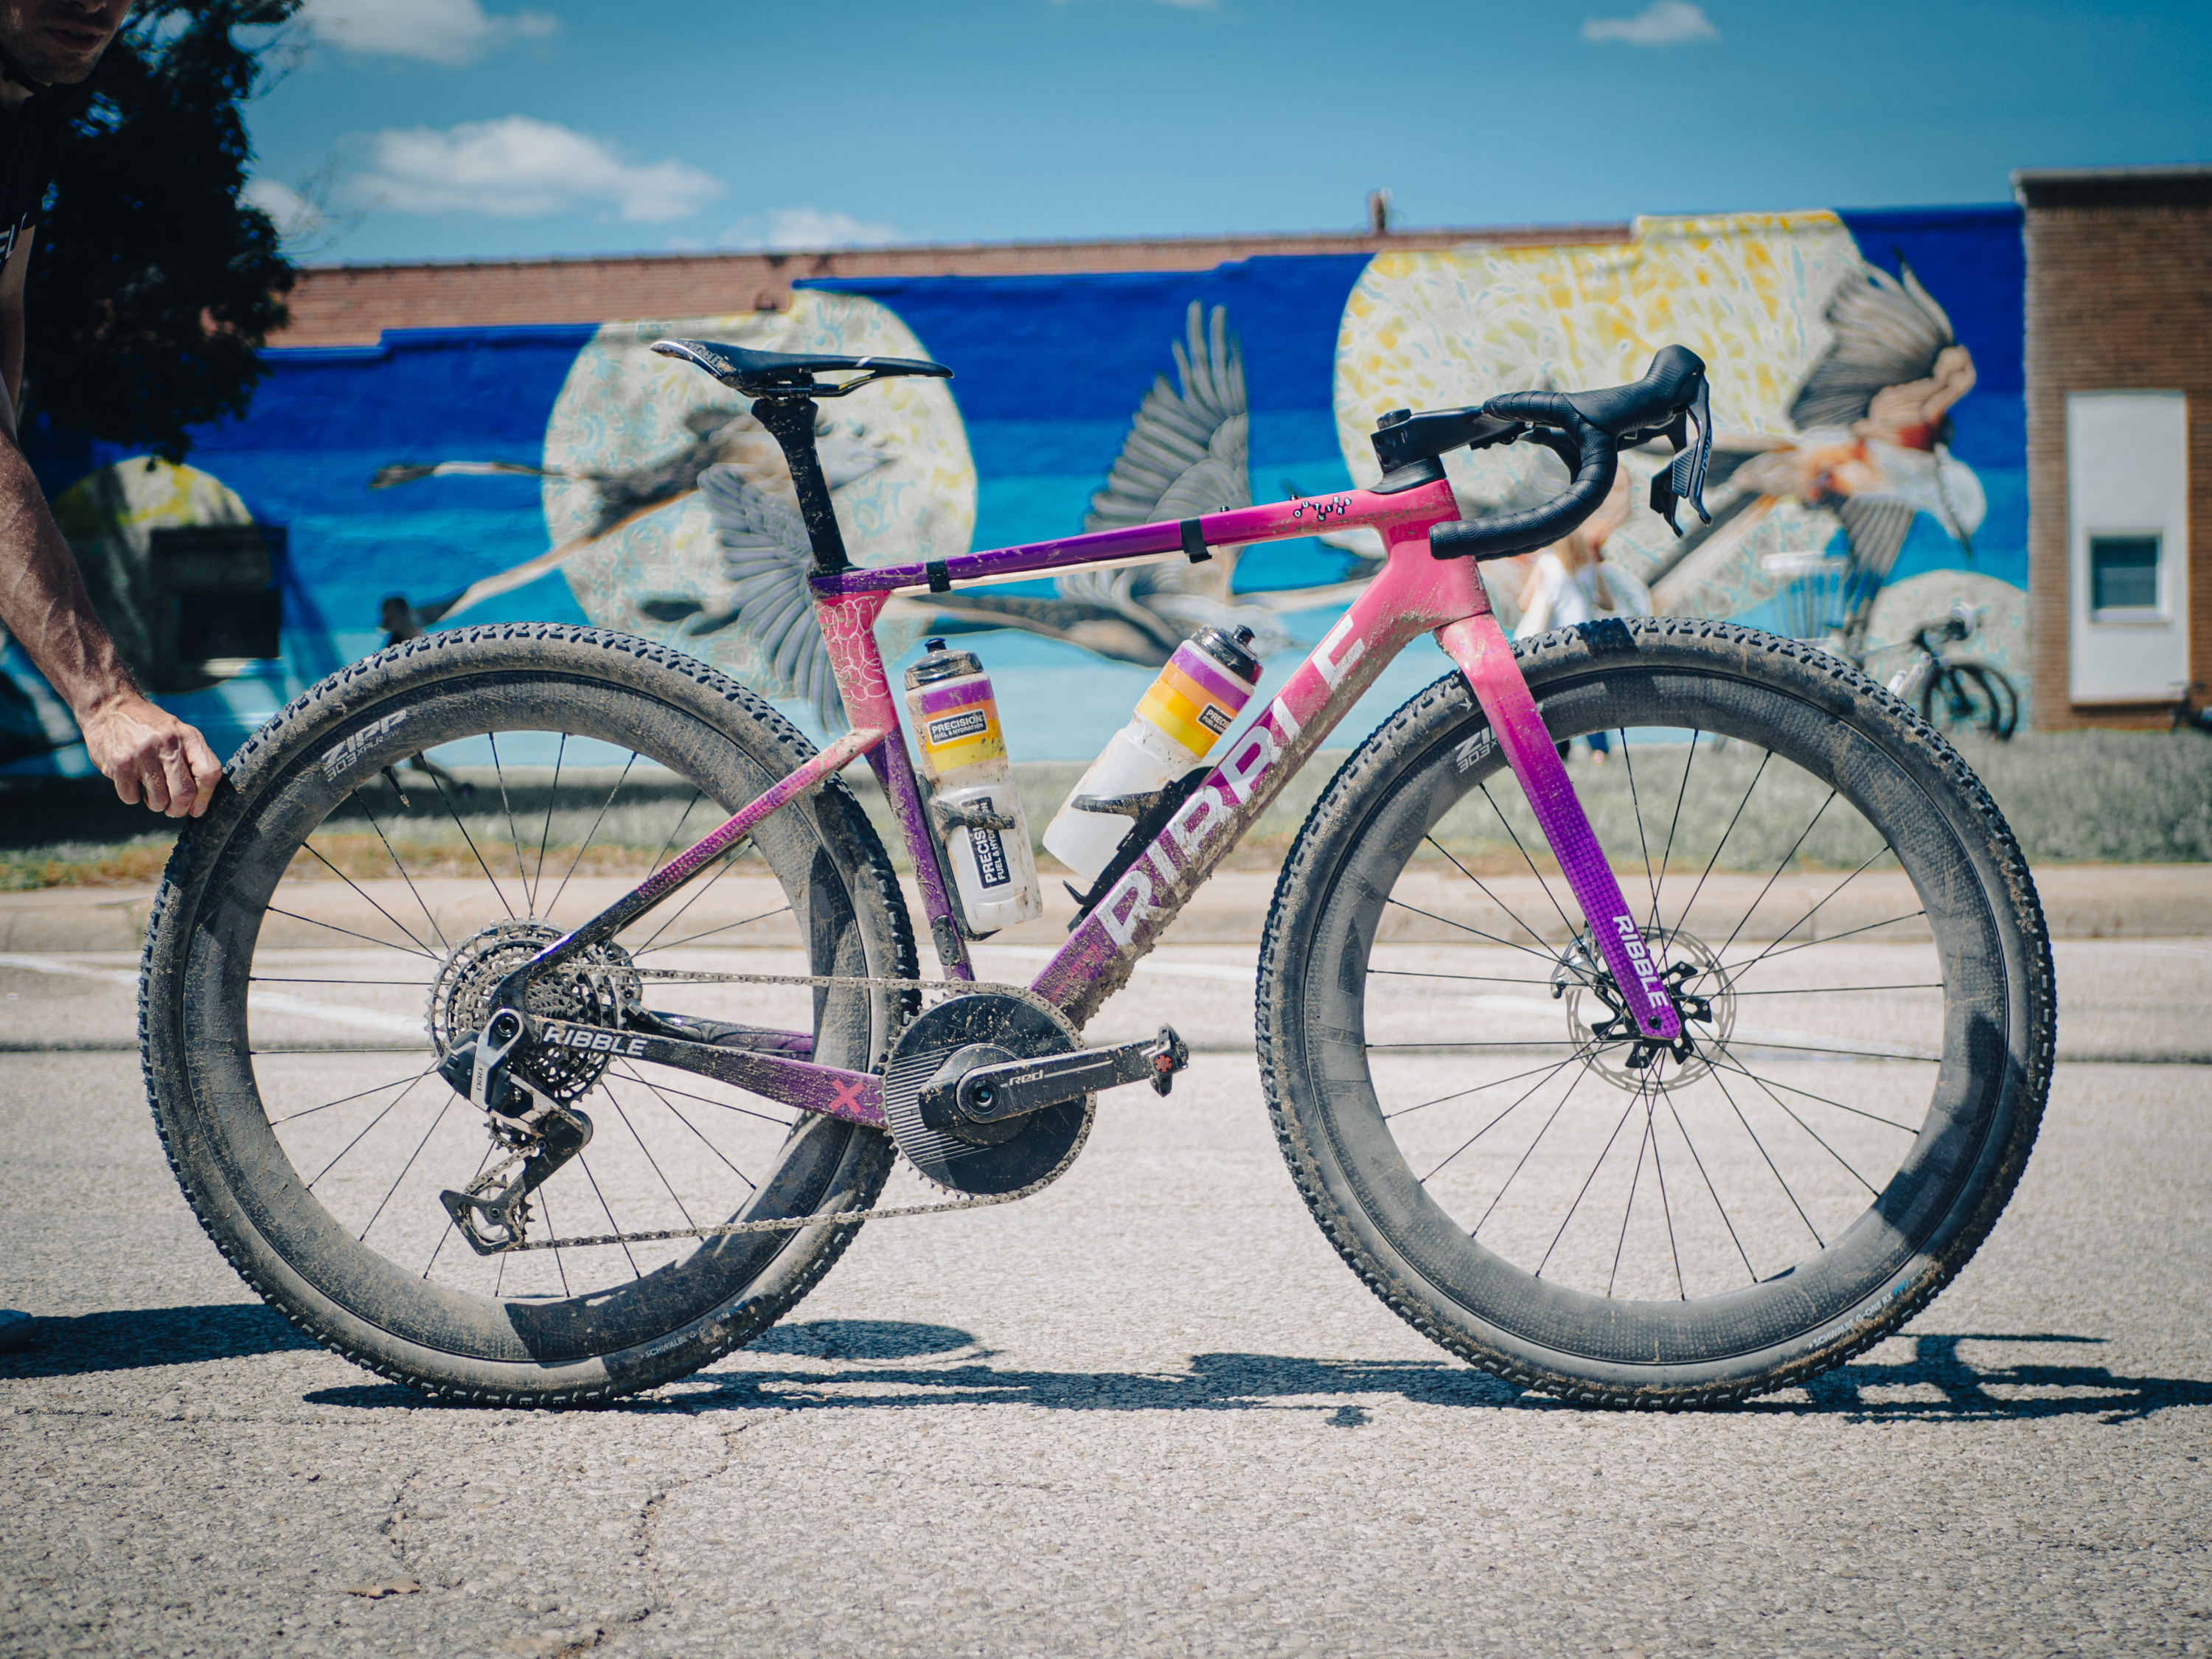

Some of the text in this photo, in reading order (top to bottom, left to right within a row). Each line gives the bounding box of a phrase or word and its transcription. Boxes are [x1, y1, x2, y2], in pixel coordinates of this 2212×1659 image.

[932, 715, 982, 734] PRECISION
[953, 723, 984, 735] HYDRATION
[321, 709, 407, 772] ZIPP
[326, 752, 357, 782] 303
[357, 736, 383, 756] XPLR
[1458, 743, 1490, 773] 303
[1095, 614, 1366, 959] RIBBLE
[995, 858, 1006, 880] FUEL
[1613, 915, 1669, 1009] RIBBLE
[543, 1026, 648, 1056] RIBBLE
[1882, 1292, 1893, 1305] RX
[1893, 1279, 1909, 1296] PRO
